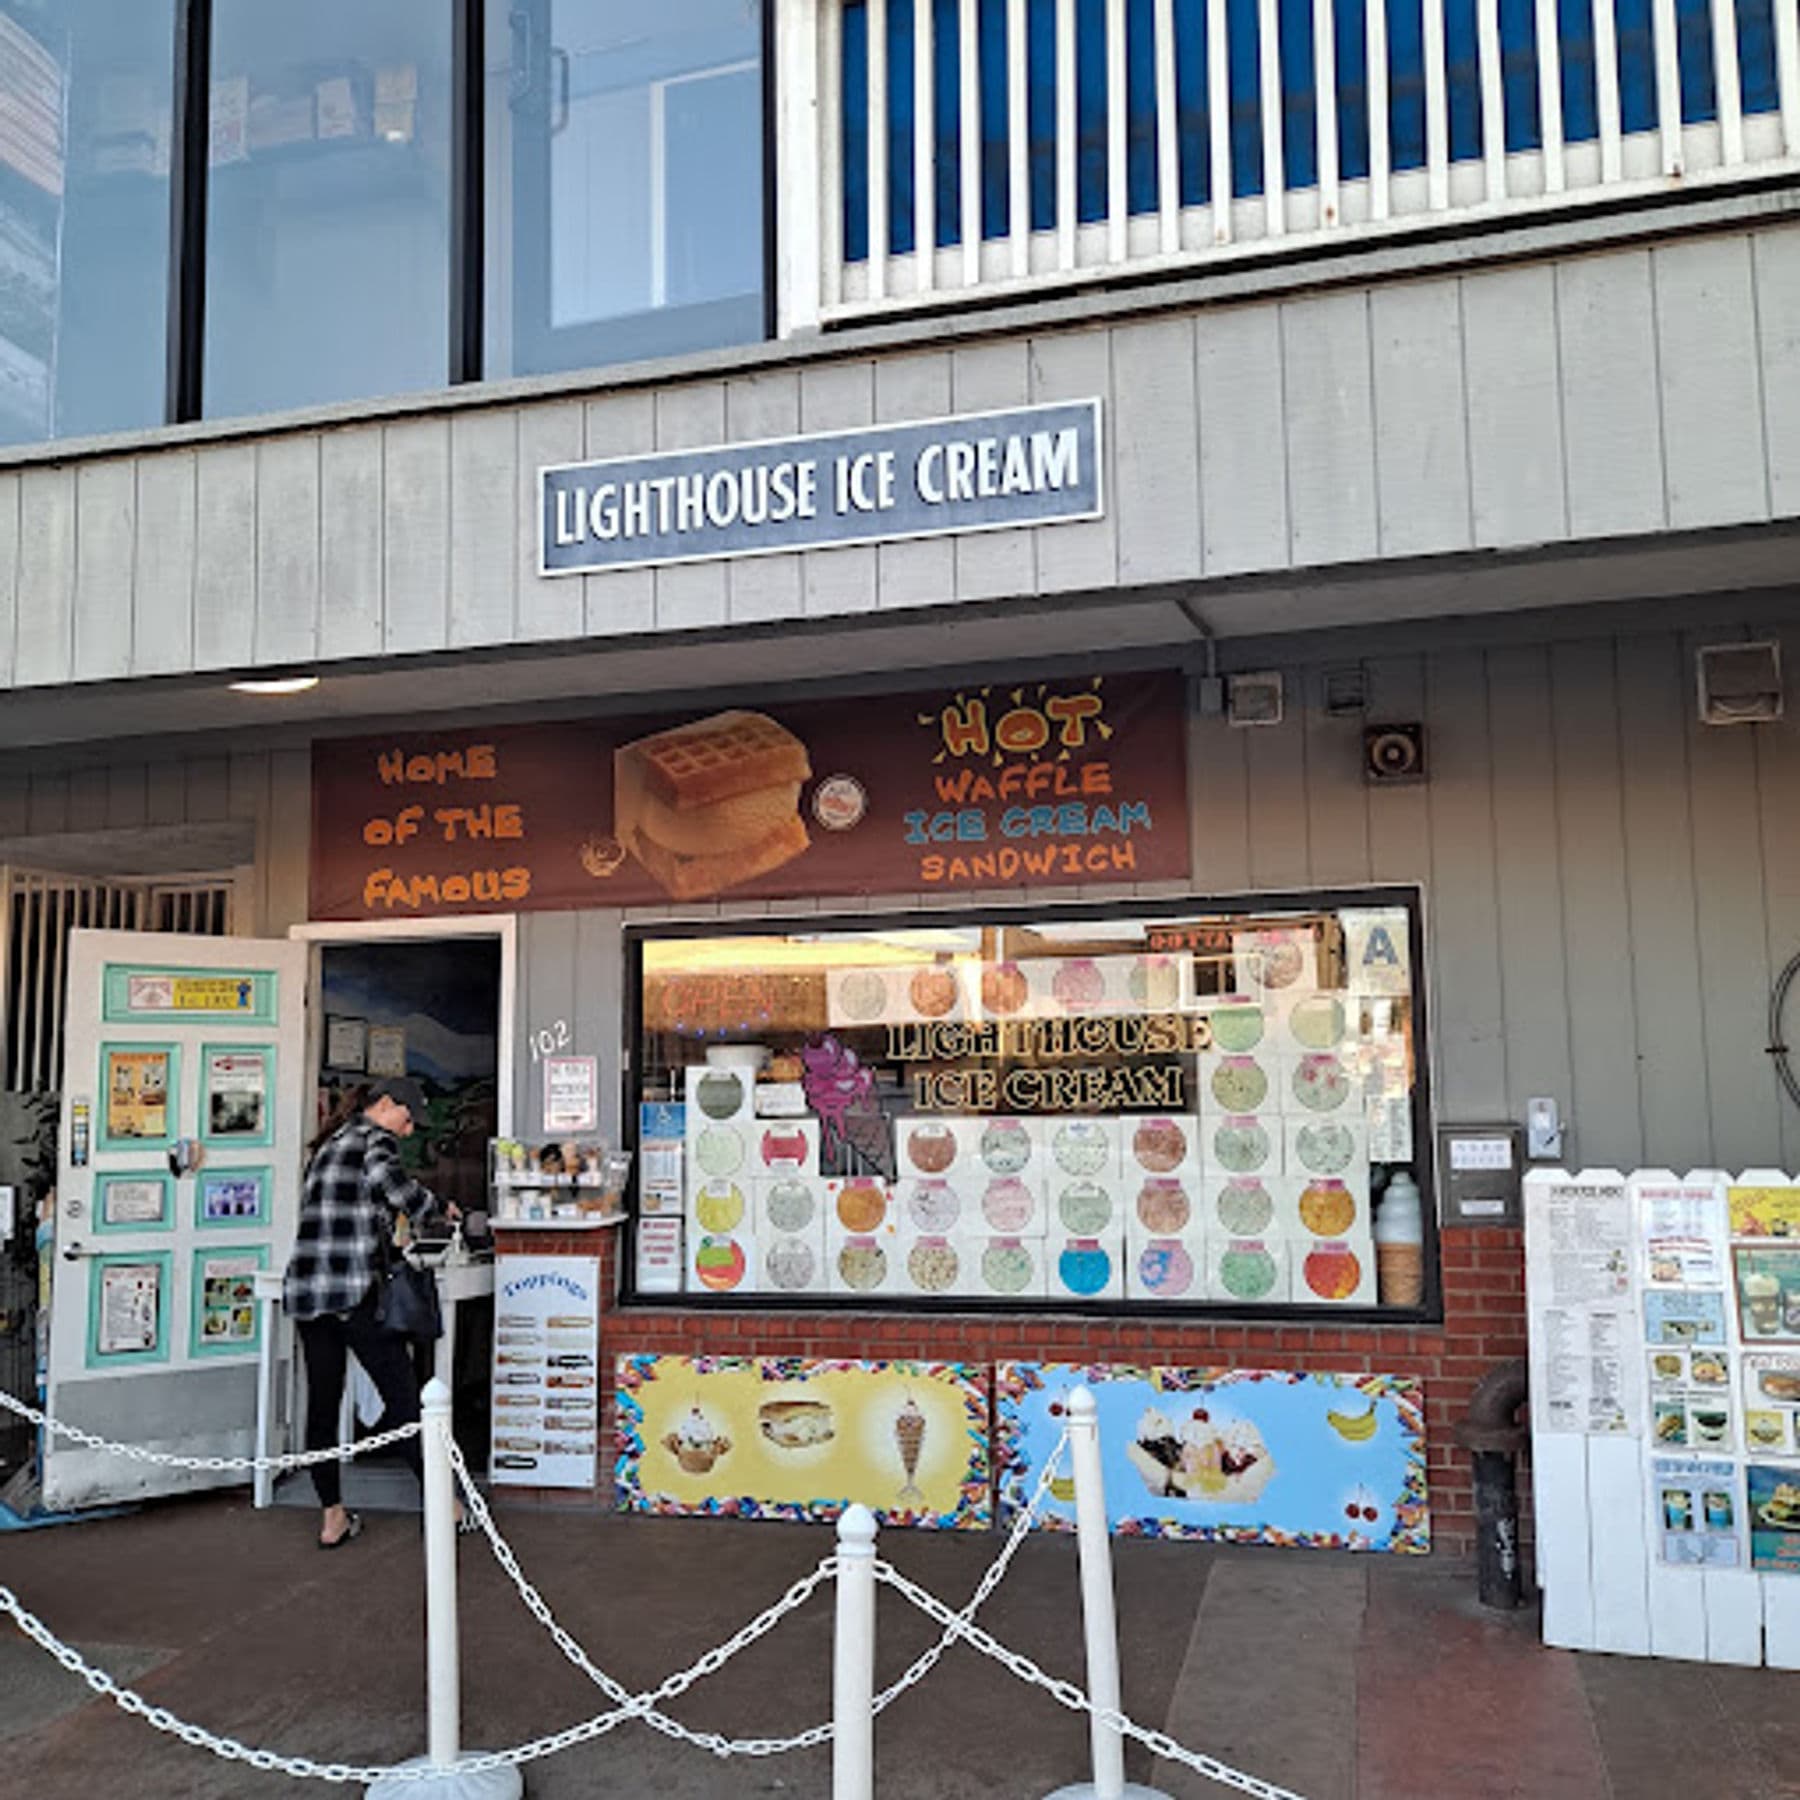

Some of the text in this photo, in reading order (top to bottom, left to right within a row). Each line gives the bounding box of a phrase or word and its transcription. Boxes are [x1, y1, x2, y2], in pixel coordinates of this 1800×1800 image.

[555, 427, 1079, 546] LIGHTHOUSE ICE CREAM
[942, 694, 1101, 756] HOT
[378, 745, 497, 785] HOME
[934, 762, 1113, 802] WAFFLE
[364, 804, 523, 846] OF THE
[904, 801, 1152, 845] ICE CREAM
[920, 841, 1137, 882] SANDWICH
[364, 866, 532, 908] FAMOUS
[1362, 926, 1399, 966] A
[530, 1020, 571, 1062] 102
[886, 1014, 1212, 1060] LIGHTHOUSE
[914, 1066, 1184, 1111] ICE CREAM
